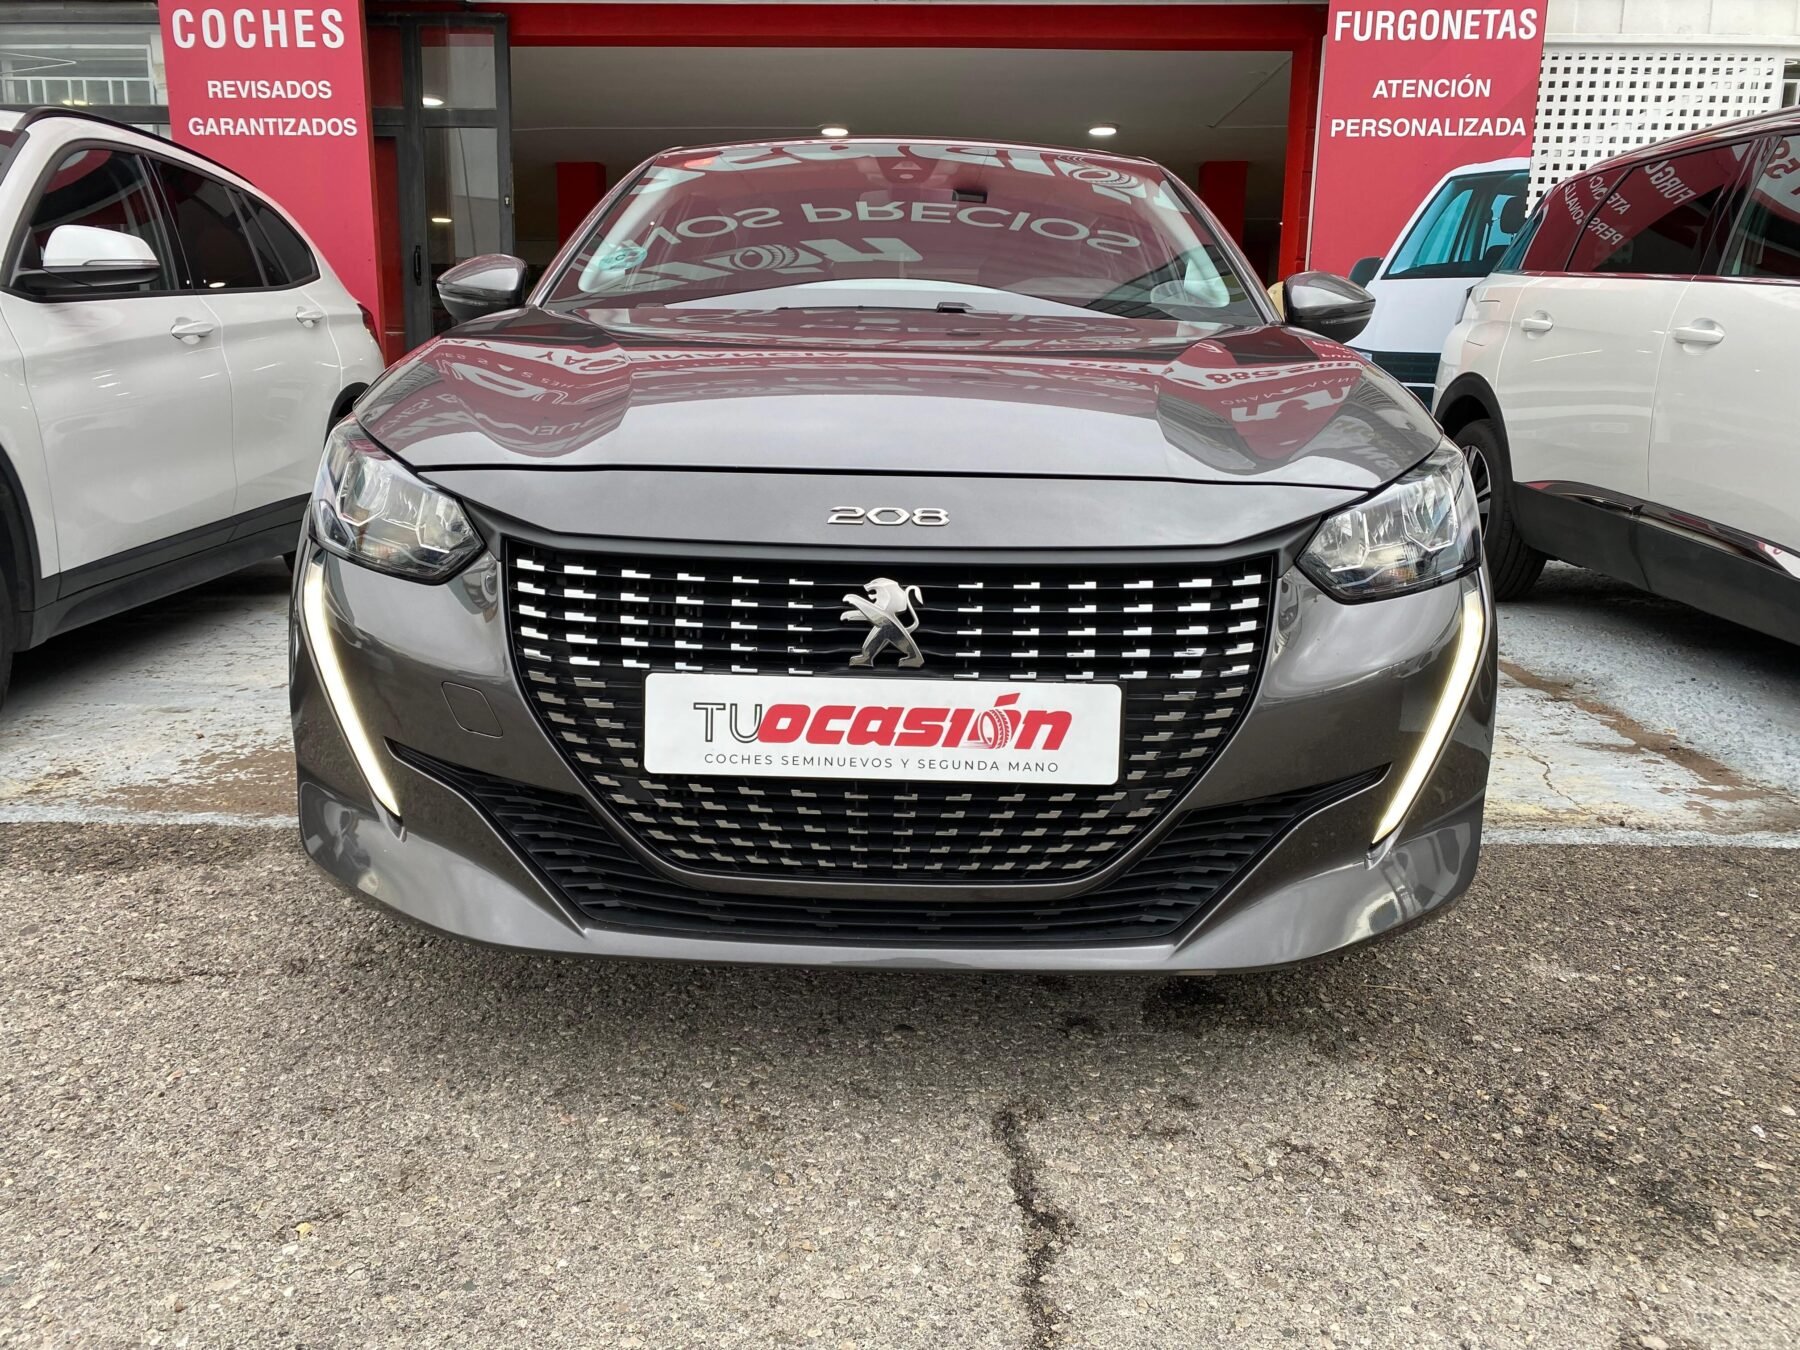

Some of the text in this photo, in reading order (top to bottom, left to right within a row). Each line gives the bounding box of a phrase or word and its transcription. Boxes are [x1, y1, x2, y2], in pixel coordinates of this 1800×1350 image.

[172, 8, 345, 49] COCHES
[1334, 7, 1537, 42] FURGONETAS
[207, 80, 332, 99] REVISADOS
[1373, 74, 1491, 98] ATENCIÓN
[188, 118, 358, 137] GARANTIZADOS
[1331, 118, 1526, 138] PERSONALIZADA
[827, 506, 950, 527] 208
[704, 753, 1059, 773] COCHES SEMINUEVOS Y SEGUNDA MANO
